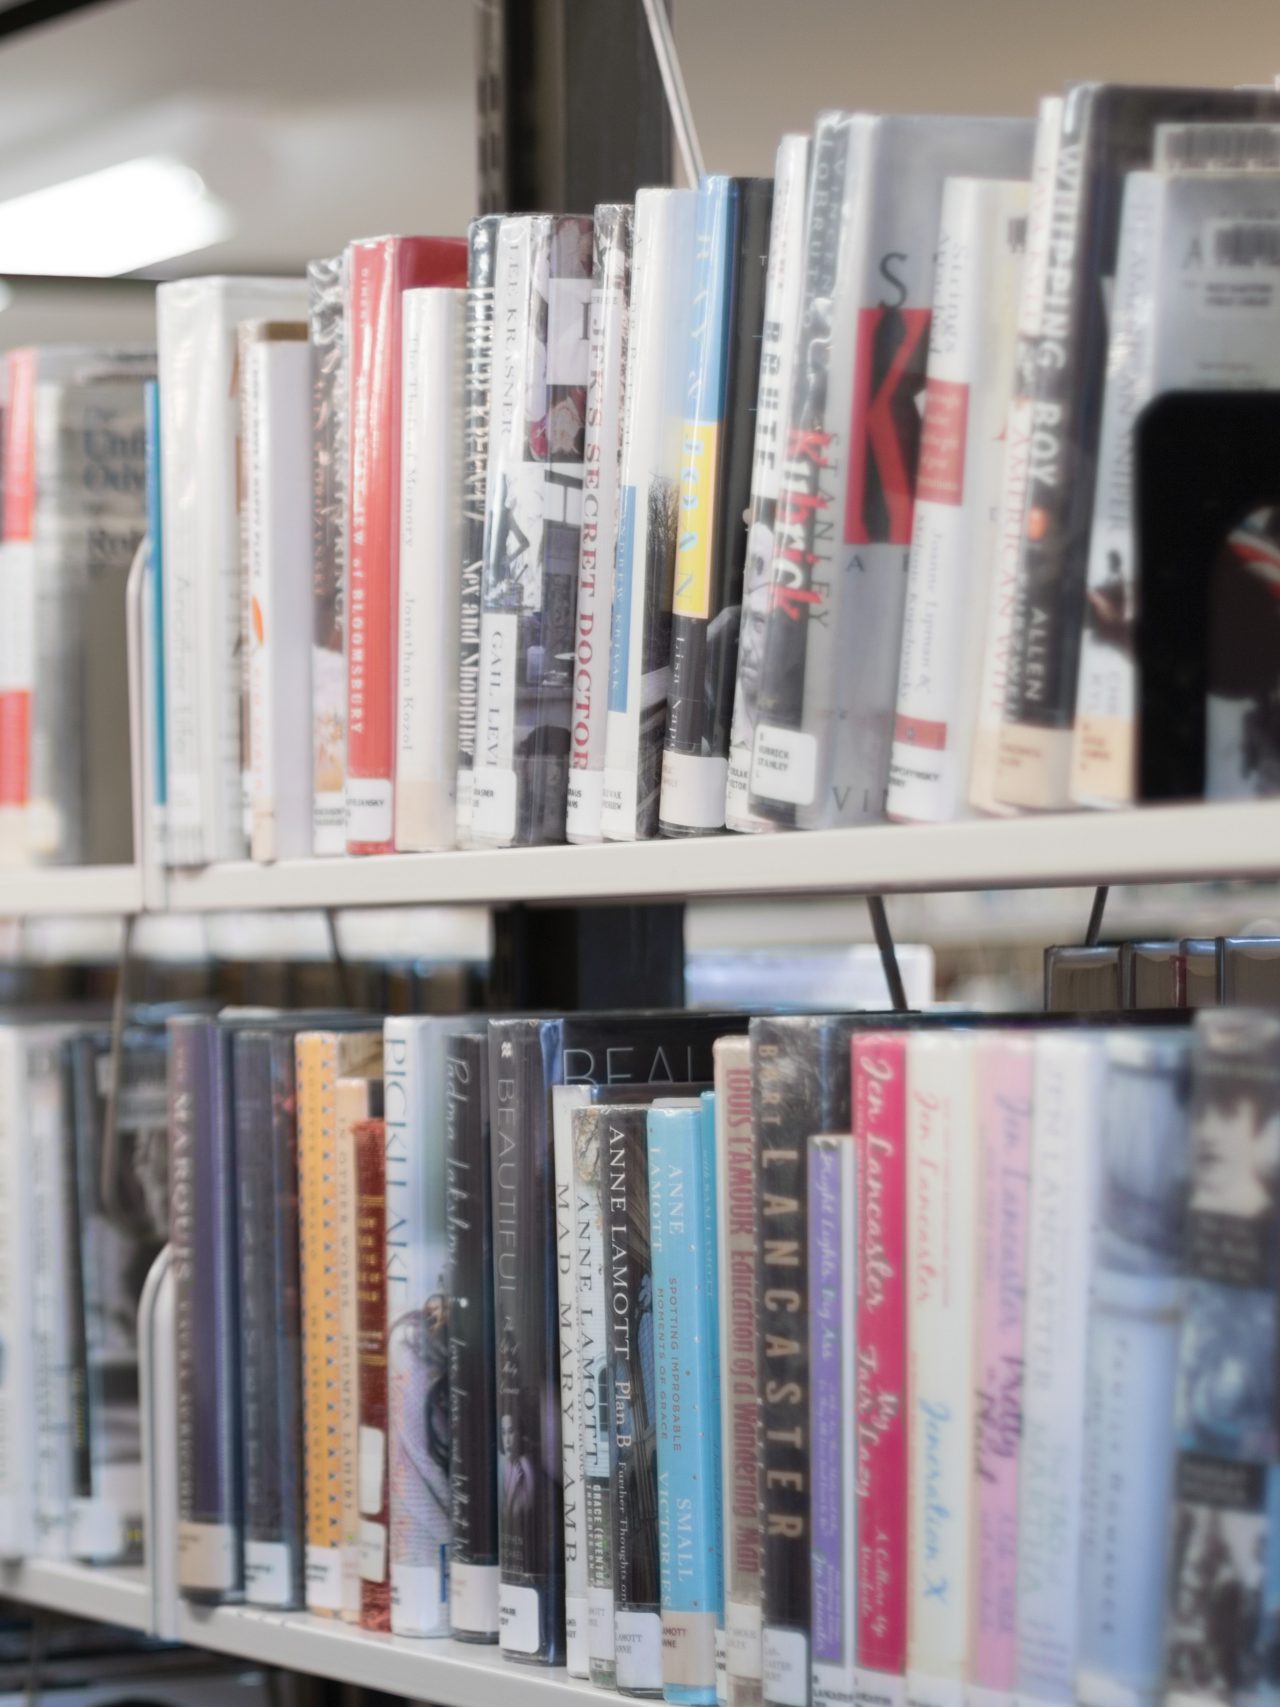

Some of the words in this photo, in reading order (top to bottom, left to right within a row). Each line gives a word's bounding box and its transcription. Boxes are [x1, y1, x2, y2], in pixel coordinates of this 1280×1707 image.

[821, 158, 846, 290] VINCEN
[1036, 143, 1082, 370] WHIPPING
[507, 245, 521, 297] LEE
[500, 308, 519, 436] KRASNER
[587, 319, 606, 428] JFK'S
[1029, 402, 1064, 488] BOY
[404, 469, 418, 549] Memory
[581, 443, 601, 598] SECRET
[770, 430, 833, 622] Kubrick
[809, 433, 842, 629] STANLEY
[353, 558, 366, 579] of
[461, 560, 484, 597] Sex
[350, 588, 366, 734] BLOOMSBURY
[402, 592, 416, 688] Jonathan
[460, 602, 481, 644] and
[487, 631, 504, 692] GAIL
[672, 637, 686, 684] Lisa
[1024, 607, 1051, 701] ALLEN
[401, 696, 415, 752] Kozol
[573, 611, 596, 771] DOCTOR
[486, 708, 502, 768] LEVI
[338, 1116, 348, 1140] IN
[446, 1056, 472, 1141] Padma
[726, 1069, 753, 1128] LOUIS
[859, 1055, 894, 1125] Jen
[913, 1090, 941, 1141] Jen
[173, 1091, 195, 1283] MARQUIS
[339, 1151, 349, 1223] OTHER
[609, 1126, 627, 1213] ANNE
[650, 1146, 663, 1254] LAMOTT
[668, 1163, 685, 1235] ANNE
[727, 1136, 755, 1236] L'AMOUR
[384, 1179, 408, 1298] LAKE
[557, 1183, 572, 1276] MAD
[577, 1195, 593, 1293] ANNE
[865, 1131, 895, 1316] Lancaster
[916, 1157, 940, 1303] Lancaster
[340, 1235, 350, 1309] WORDS
[611, 1224, 630, 1361] LAMOTT
[730, 1249, 757, 1353] Education
[818, 1288, 835, 1319] Big
[657, 1287, 667, 1360] MOMENTS
[668, 1277, 679, 1351] SPOTTING
[762, 1149, 803, 1538] LANCASTER
[821, 1323, 836, 1360] Ass
[341, 1335, 352, 1423] JHUMPA
[559, 1301, 575, 1425] MARY
[580, 1308, 599, 1467] LAMOTT
[659, 1365, 667, 1385] OF
[729, 1357, 757, 1379] of
[732, 1381, 754, 1395] a
[857, 1344, 879, 1415] Fair
[615, 1381, 632, 1426] Plan
[616, 1433, 632, 1448] B
[660, 1390, 669, 1441] GRACE
[671, 1356, 682, 1452] IMPROBABLE
[870, 1386, 899, 1431] My
[343, 1433, 353, 1514] LAHIRI
[617, 1461, 627, 1513] Further
[733, 1401, 760, 1519] Wandering
[856, 1424, 881, 1497] Lazy
[918, 1397, 951, 1563] Jeneration
[449, 1472, 468, 1529] What
[562, 1441, 578, 1563] LAMB
[592, 1484, 603, 1523] GRACE
[658, 1471, 673, 1607] VICTORIES
[594, 1528, 605, 1588] (EVENTUA
[617, 1518, 629, 1581] Thoughts
[676, 1497, 693, 1583] SMALL
[734, 1526, 760, 1573] Man
[620, 1583, 628, 1601] on
[922, 1572, 949, 1604] X
